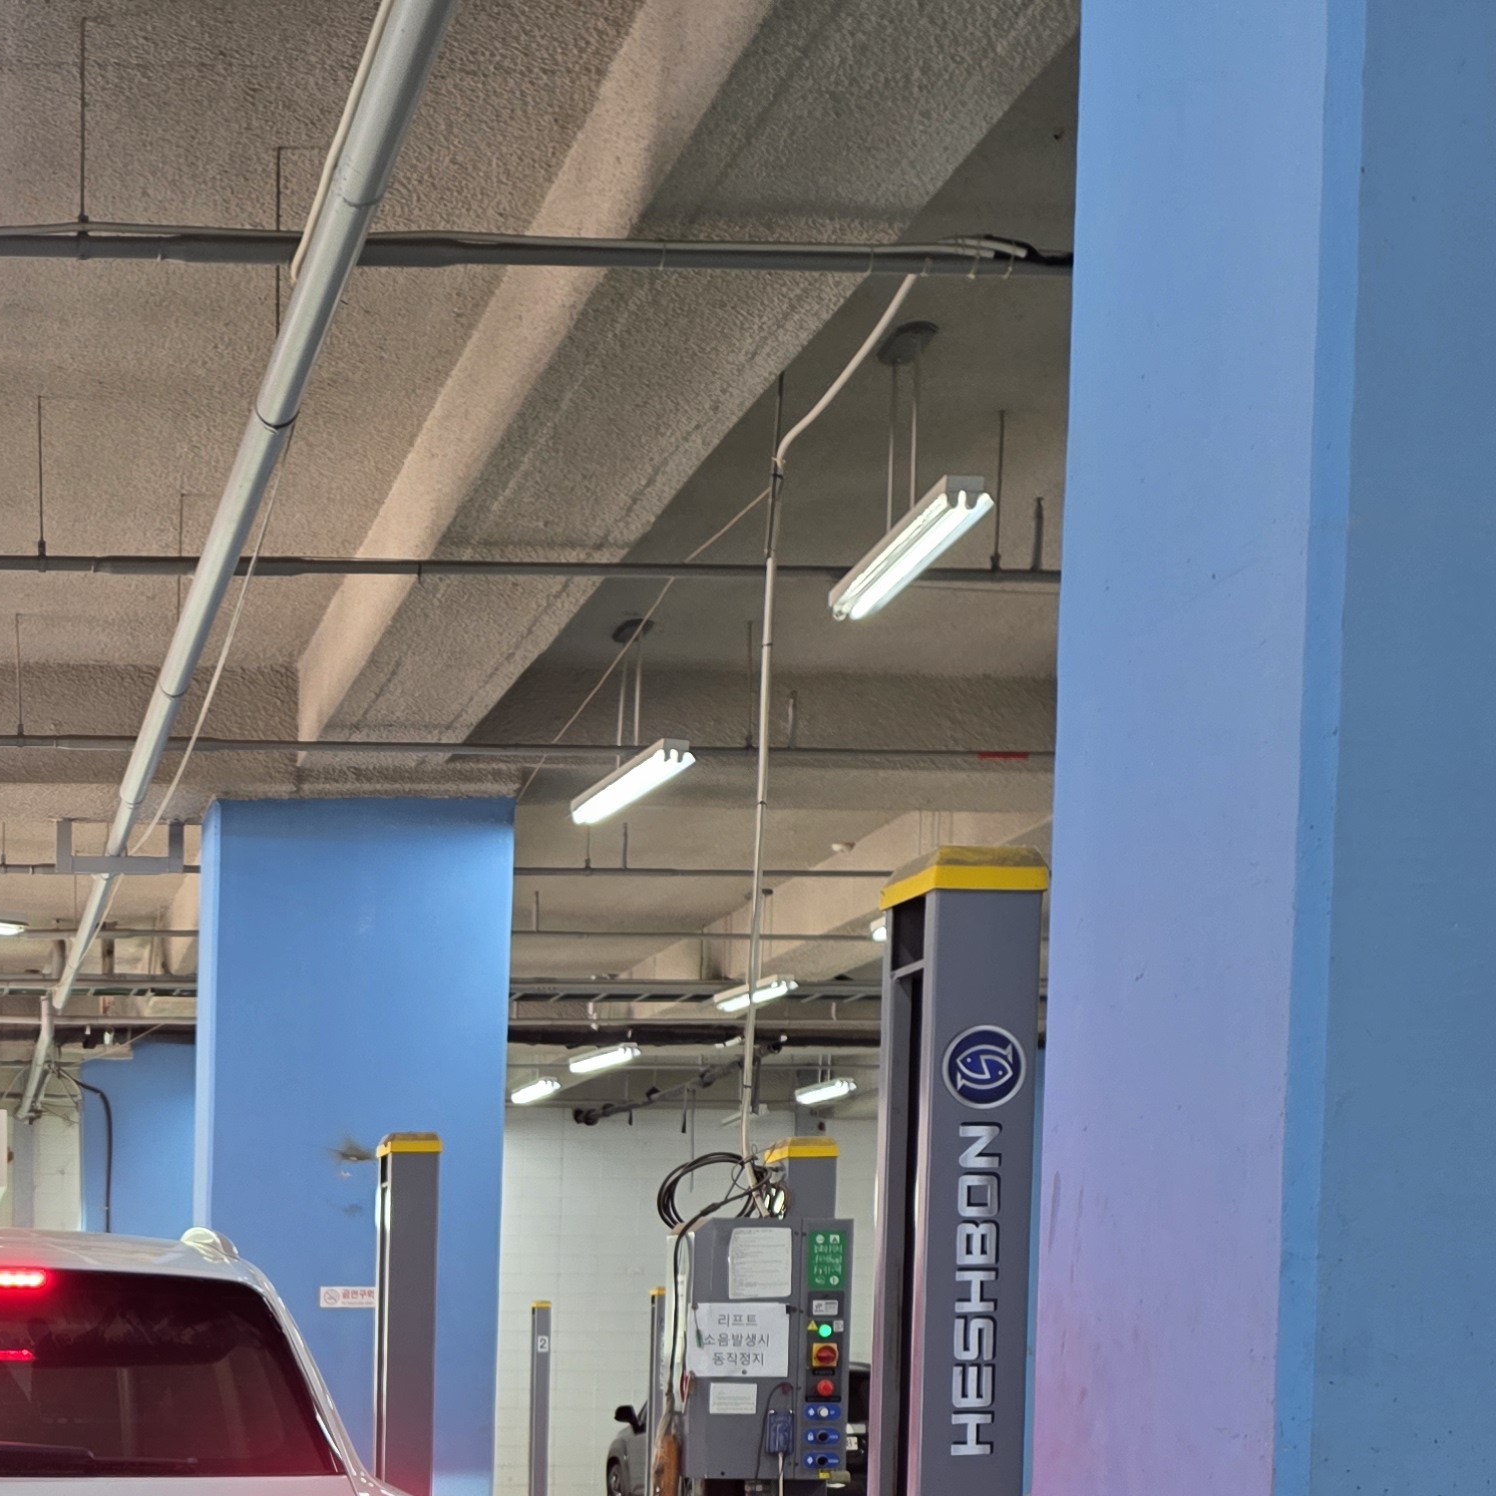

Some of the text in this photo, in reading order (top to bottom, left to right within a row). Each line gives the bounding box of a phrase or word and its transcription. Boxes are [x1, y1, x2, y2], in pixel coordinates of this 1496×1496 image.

[950, 1121, 1003, 1457] HESHBON
[718, 1313, 759, 1327] 리프트
[539, 1338, 547, 1349] 2
[704, 1332, 770, 1348] 소음발생시
[712, 1351, 765, 1367] 동작정지
